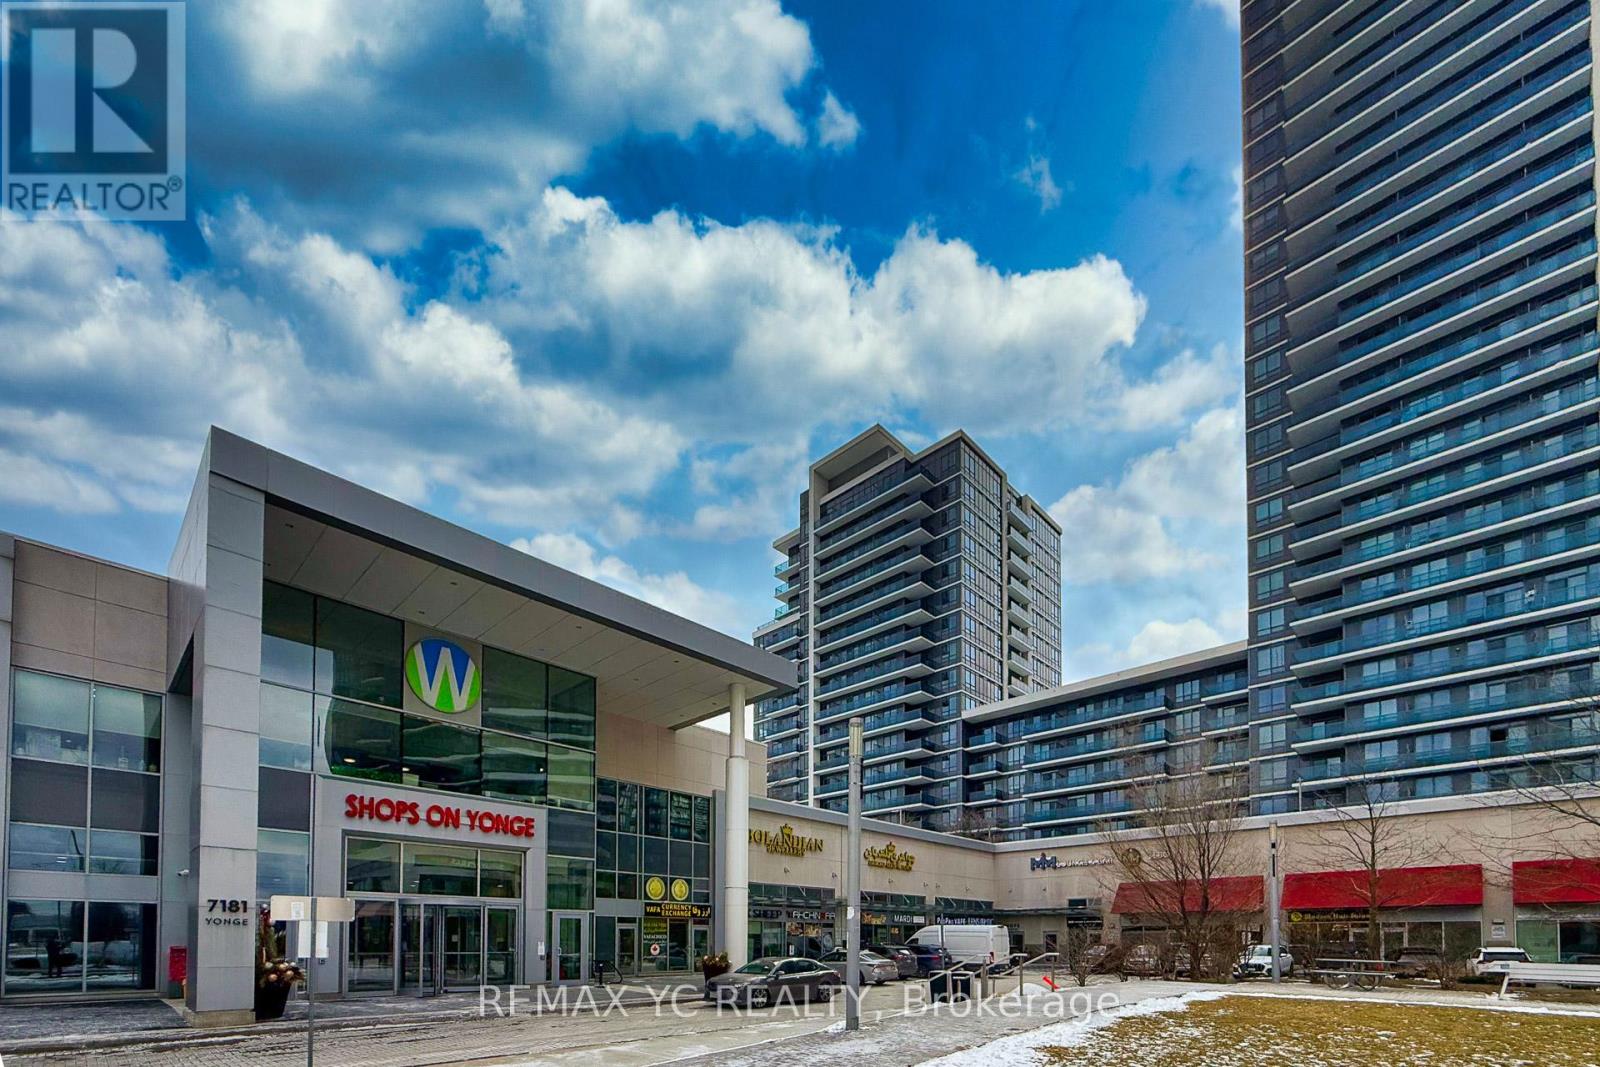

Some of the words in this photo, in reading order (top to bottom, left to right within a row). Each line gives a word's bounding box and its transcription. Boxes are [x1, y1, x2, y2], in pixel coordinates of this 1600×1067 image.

[345, 794, 419, 825] SHOPS
[426, 805, 460, 829] ON
[466, 809, 535, 837] YONGE
[207, 899, 248, 913] 7181
[661, 909, 692, 917] EXCHANGE
[205, 917, 248, 926] YONGE
[894, 914, 913, 923] MARDI
